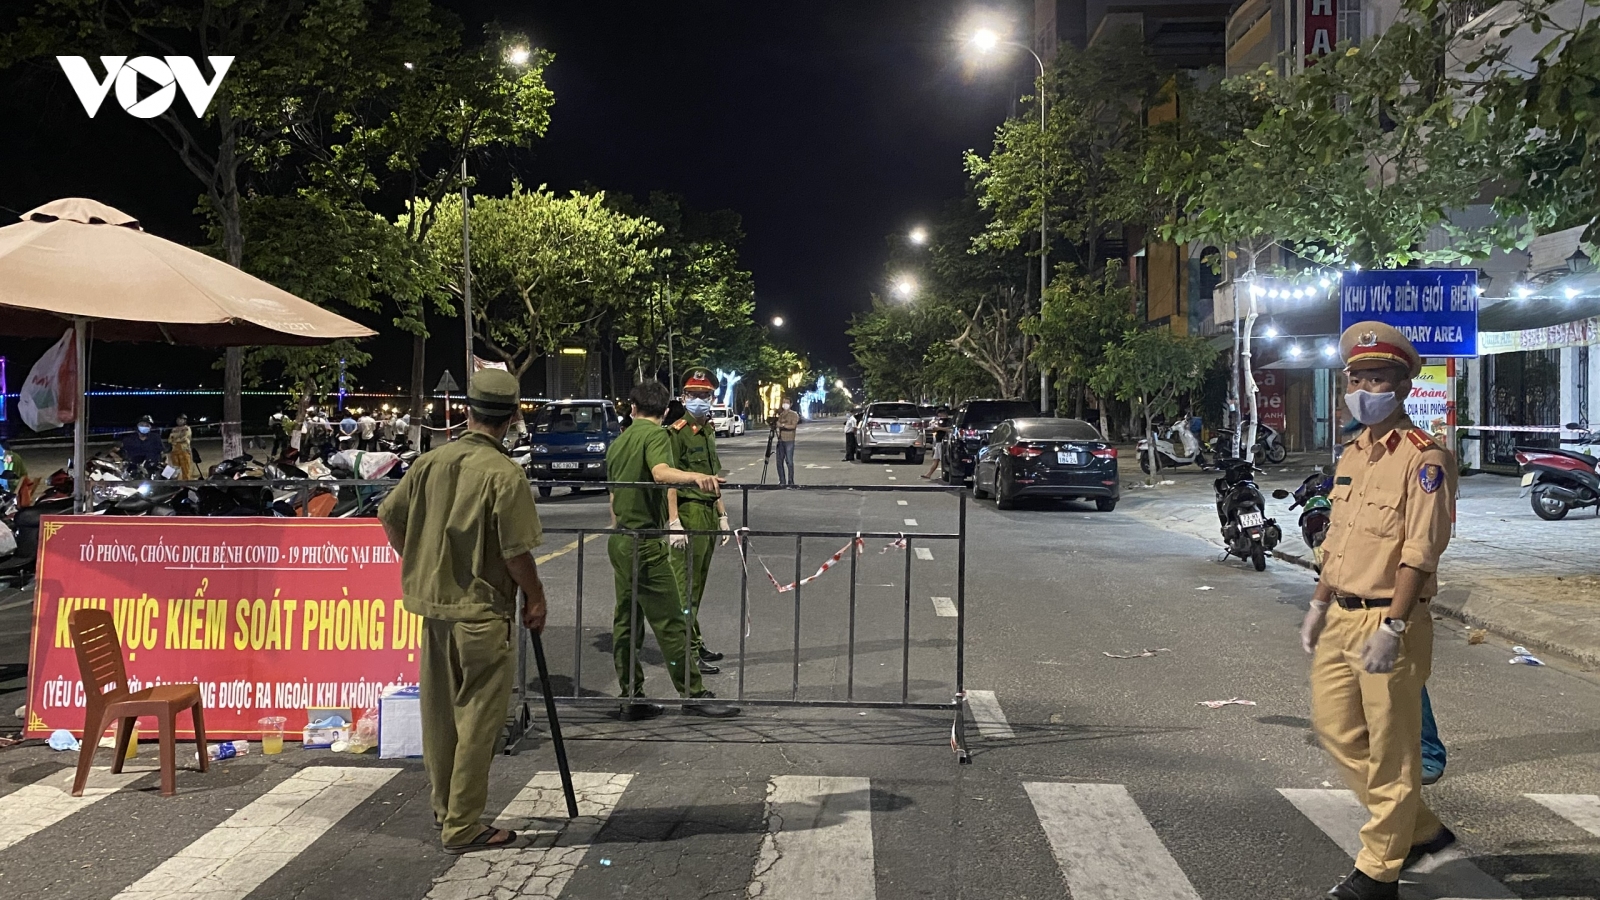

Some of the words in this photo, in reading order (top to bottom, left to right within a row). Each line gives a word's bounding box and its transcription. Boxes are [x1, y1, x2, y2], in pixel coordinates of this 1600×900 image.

[1344, 285, 1367, 312] KHU
[1370, 280, 1392, 315] VỰC
[1394, 280, 1419, 312] BIÊN
[1421, 275, 1443, 312] GIỚI
[1450, 274, 1474, 312] BIỂN
[1434, 326, 1463, 342] AREA
[1420, 400, 1429, 415] HẢI
[79, 534, 95, 562] TỔ
[96, 539, 138, 566] PHÒNG,
[140, 536, 180, 563] CHỐNG
[182, 545, 210, 568] DỊCH
[212, 541, 243, 568] BỆNH
[245, 545, 280, 563] COVID
[288, 546, 299, 564] 19
[301, 541, 349, 564] PHƯỜNG
[351, 546, 370, 569] NẠI
[113, 592, 159, 662] VỰC
[165, 577, 228, 650] KIỂM
[233, 588, 297, 650] SOÁT
[302, 586, 385, 651] PHÒNG
[42, 674, 72, 709] (YÊU
[218, 679, 252, 715] ĐƯỢC
[255, 682, 272, 709] RA
[274, 677, 313, 709] NGOÀI
[316, 682, 337, 709] KHI
[341, 676, 383, 709] KHÔNG
